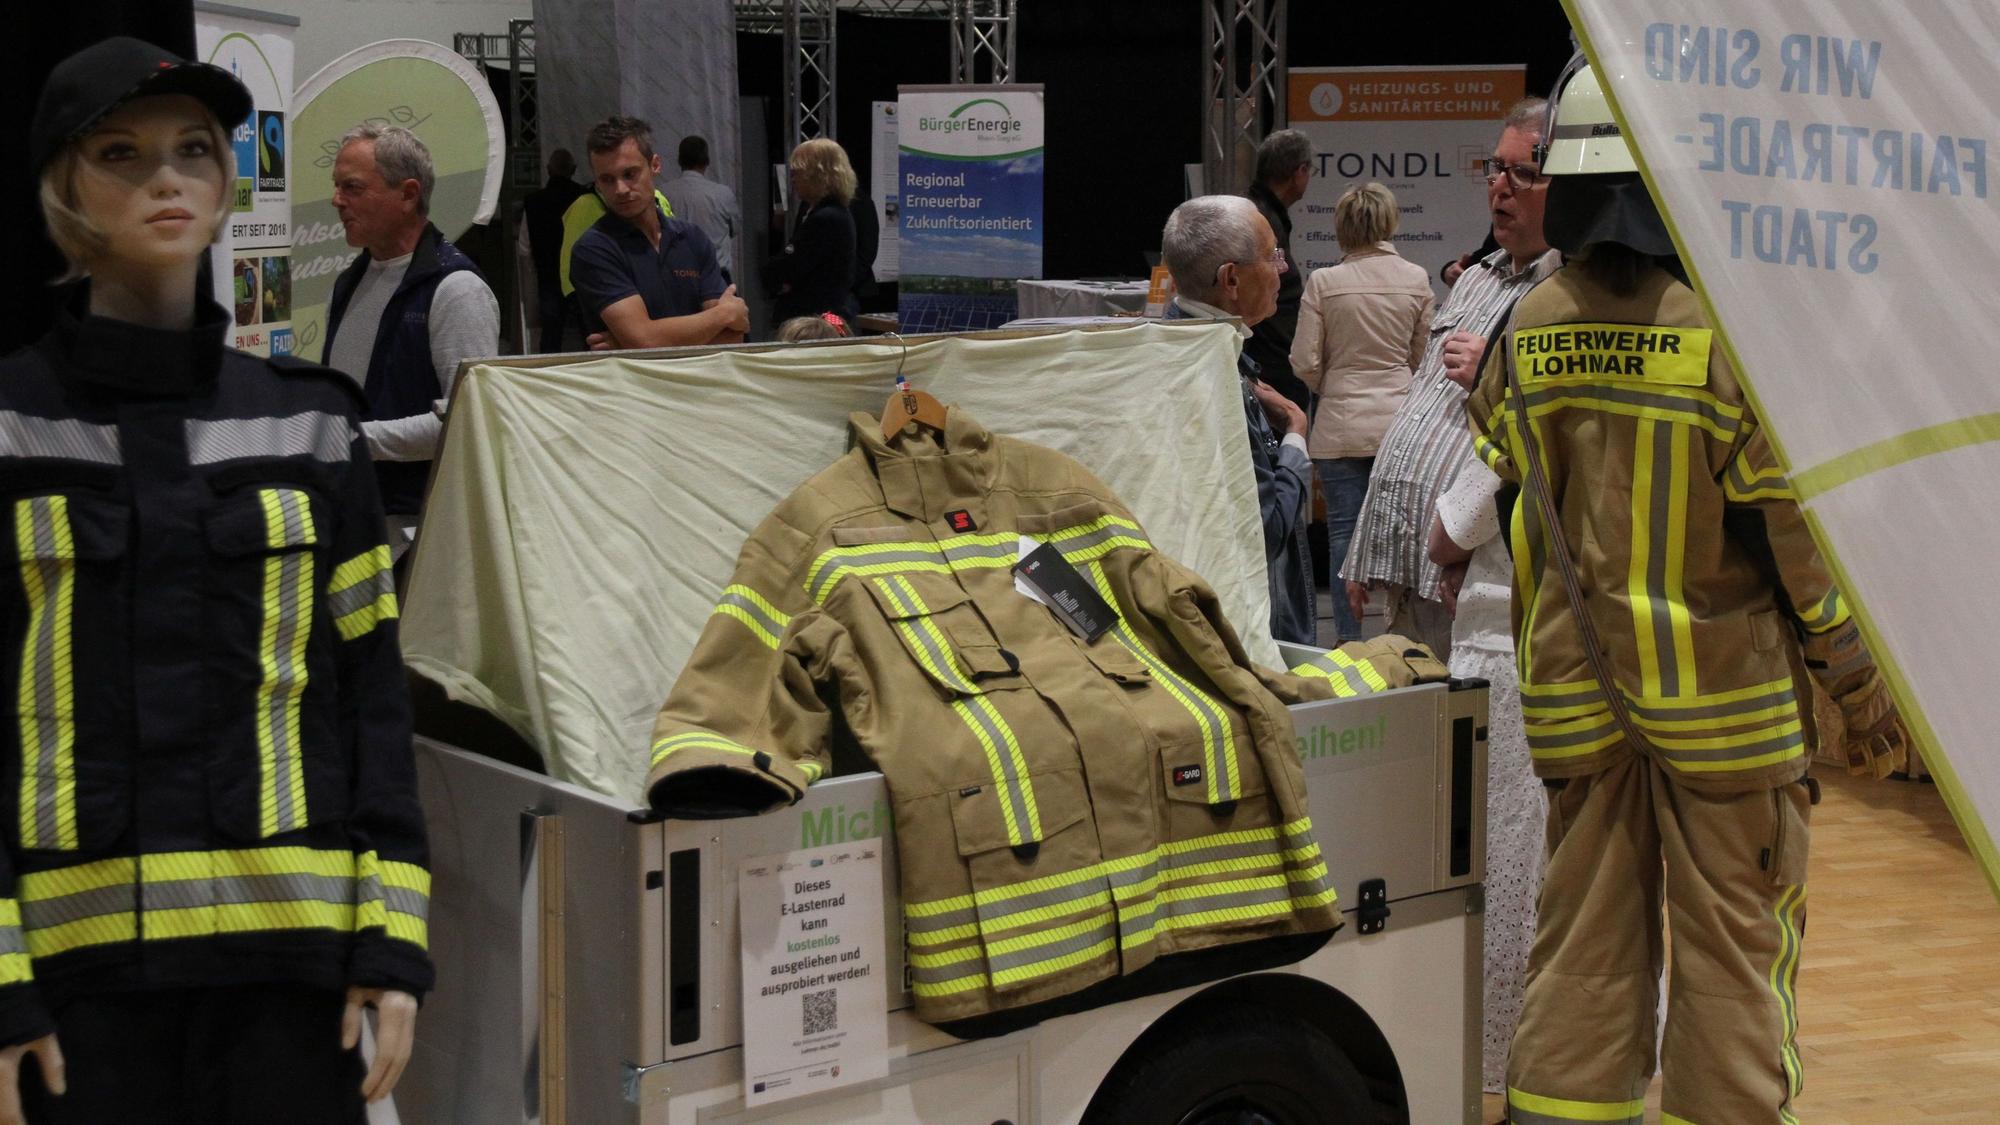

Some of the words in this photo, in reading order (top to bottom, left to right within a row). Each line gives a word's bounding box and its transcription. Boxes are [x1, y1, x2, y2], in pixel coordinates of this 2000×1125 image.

[1350, 82, 1447, 95] HEIZUNGS-
[1455, 82, 1494, 94] UND
[1350, 99, 1501, 113] SANITÄRTECHNIK
[919, 117, 1021, 134] BürgerEnergie
[1592, 125, 1622, 136] Bulla
[1317, 153, 1451, 178] TONDL
[906, 173, 965, 189] Regional
[906, 194, 982, 208] Erneuerbar
[249, 224, 266, 237] SEIT
[268, 223, 287, 236] 2018
[906, 215, 1032, 230] Zukunftsorientiert
[1517, 331, 1681, 357] FEUERWEHR
[1532, 355, 1645, 376] LOHMAR
[794, 879, 832, 895] Dieses
[781, 893, 846, 916] E-Lastenrad
[801, 918, 828, 931] kann
[787, 935, 840, 953] kostenlos
[770, 955, 838, 975] ausgeliehen
[840, 947, 861, 960] und
[761, 974, 825, 997] ausprobiert
[827, 964, 870, 983] werden!
